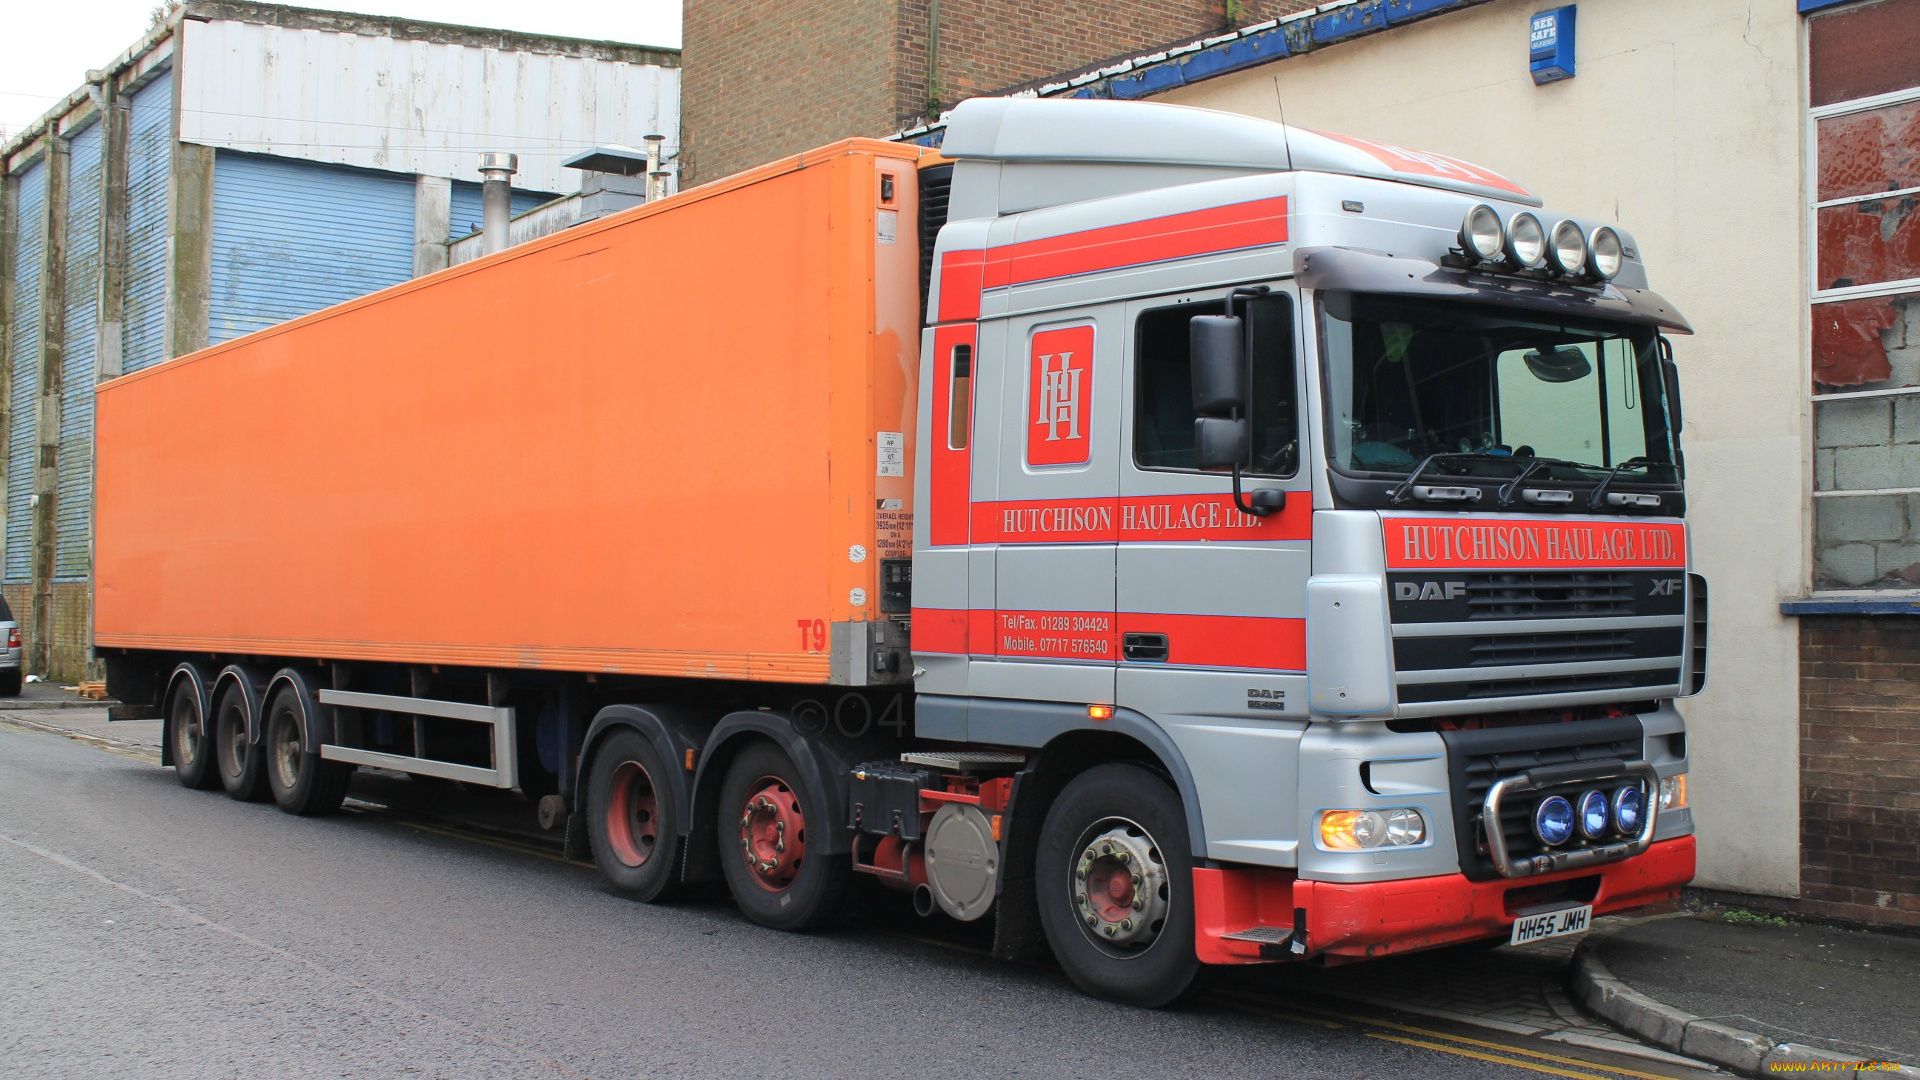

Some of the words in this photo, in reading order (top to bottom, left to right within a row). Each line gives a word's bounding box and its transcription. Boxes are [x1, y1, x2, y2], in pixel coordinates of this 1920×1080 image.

[1533, 17, 1553, 31] BEE
[1531, 27, 1556, 42] SAFE
[1002, 505, 1112, 533] HUTCHISON
[1121, 502, 1222, 531] HAULAGE
[1402, 525, 1540, 561] HUTCHISON
[1544, 527, 1637, 561] HAULAGE
[1640, 528, 1677, 560] LTD.
[1395, 581, 1466, 601] DAF
[1648, 578, 1683, 596] XF
[1002, 614, 1038, 631] Tel/Fax.
[1041, 616, 1070, 631] 01289
[1072, 617, 1109, 632] 304424
[797, 618, 826, 651] T9
[1003, 635, 1038, 651] Mobile.
[1040, 637, 1069, 653] 07717
[1071, 639, 1108, 654] 576540
[1247, 688, 1285, 699] DAF
[1517, 914, 1556, 941] HH55
[1557, 909, 1587, 933] JMH
